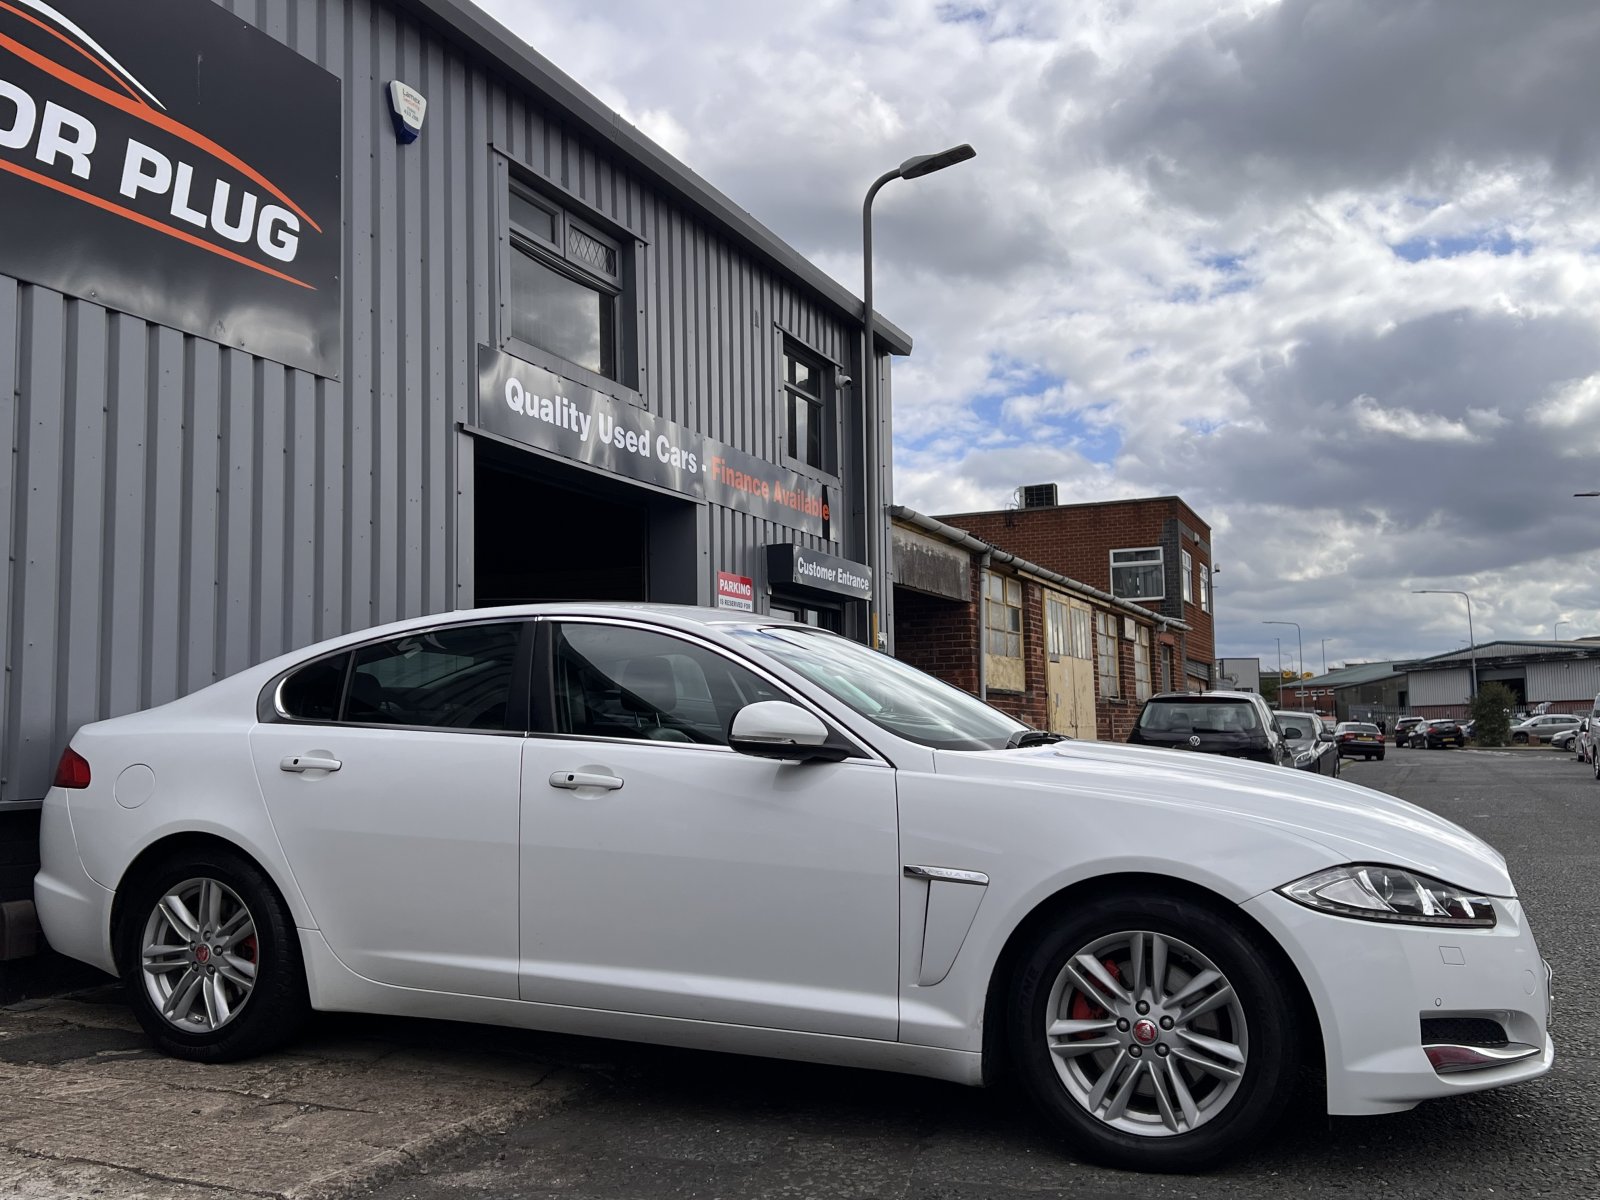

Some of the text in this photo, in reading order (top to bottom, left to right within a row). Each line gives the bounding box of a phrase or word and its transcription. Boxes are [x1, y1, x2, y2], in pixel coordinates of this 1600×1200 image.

[119, 138, 300, 262] PLUG
[505, 377, 591, 441] Quality
[599, 412, 650, 457] Used
[656, 434, 697, 473] Cars
[711, 456, 769, 498] Finance
[774, 480, 830, 521] Available
[720, 579, 751, 596] PARKING
[797, 557, 869, 590] Customer Entrance
